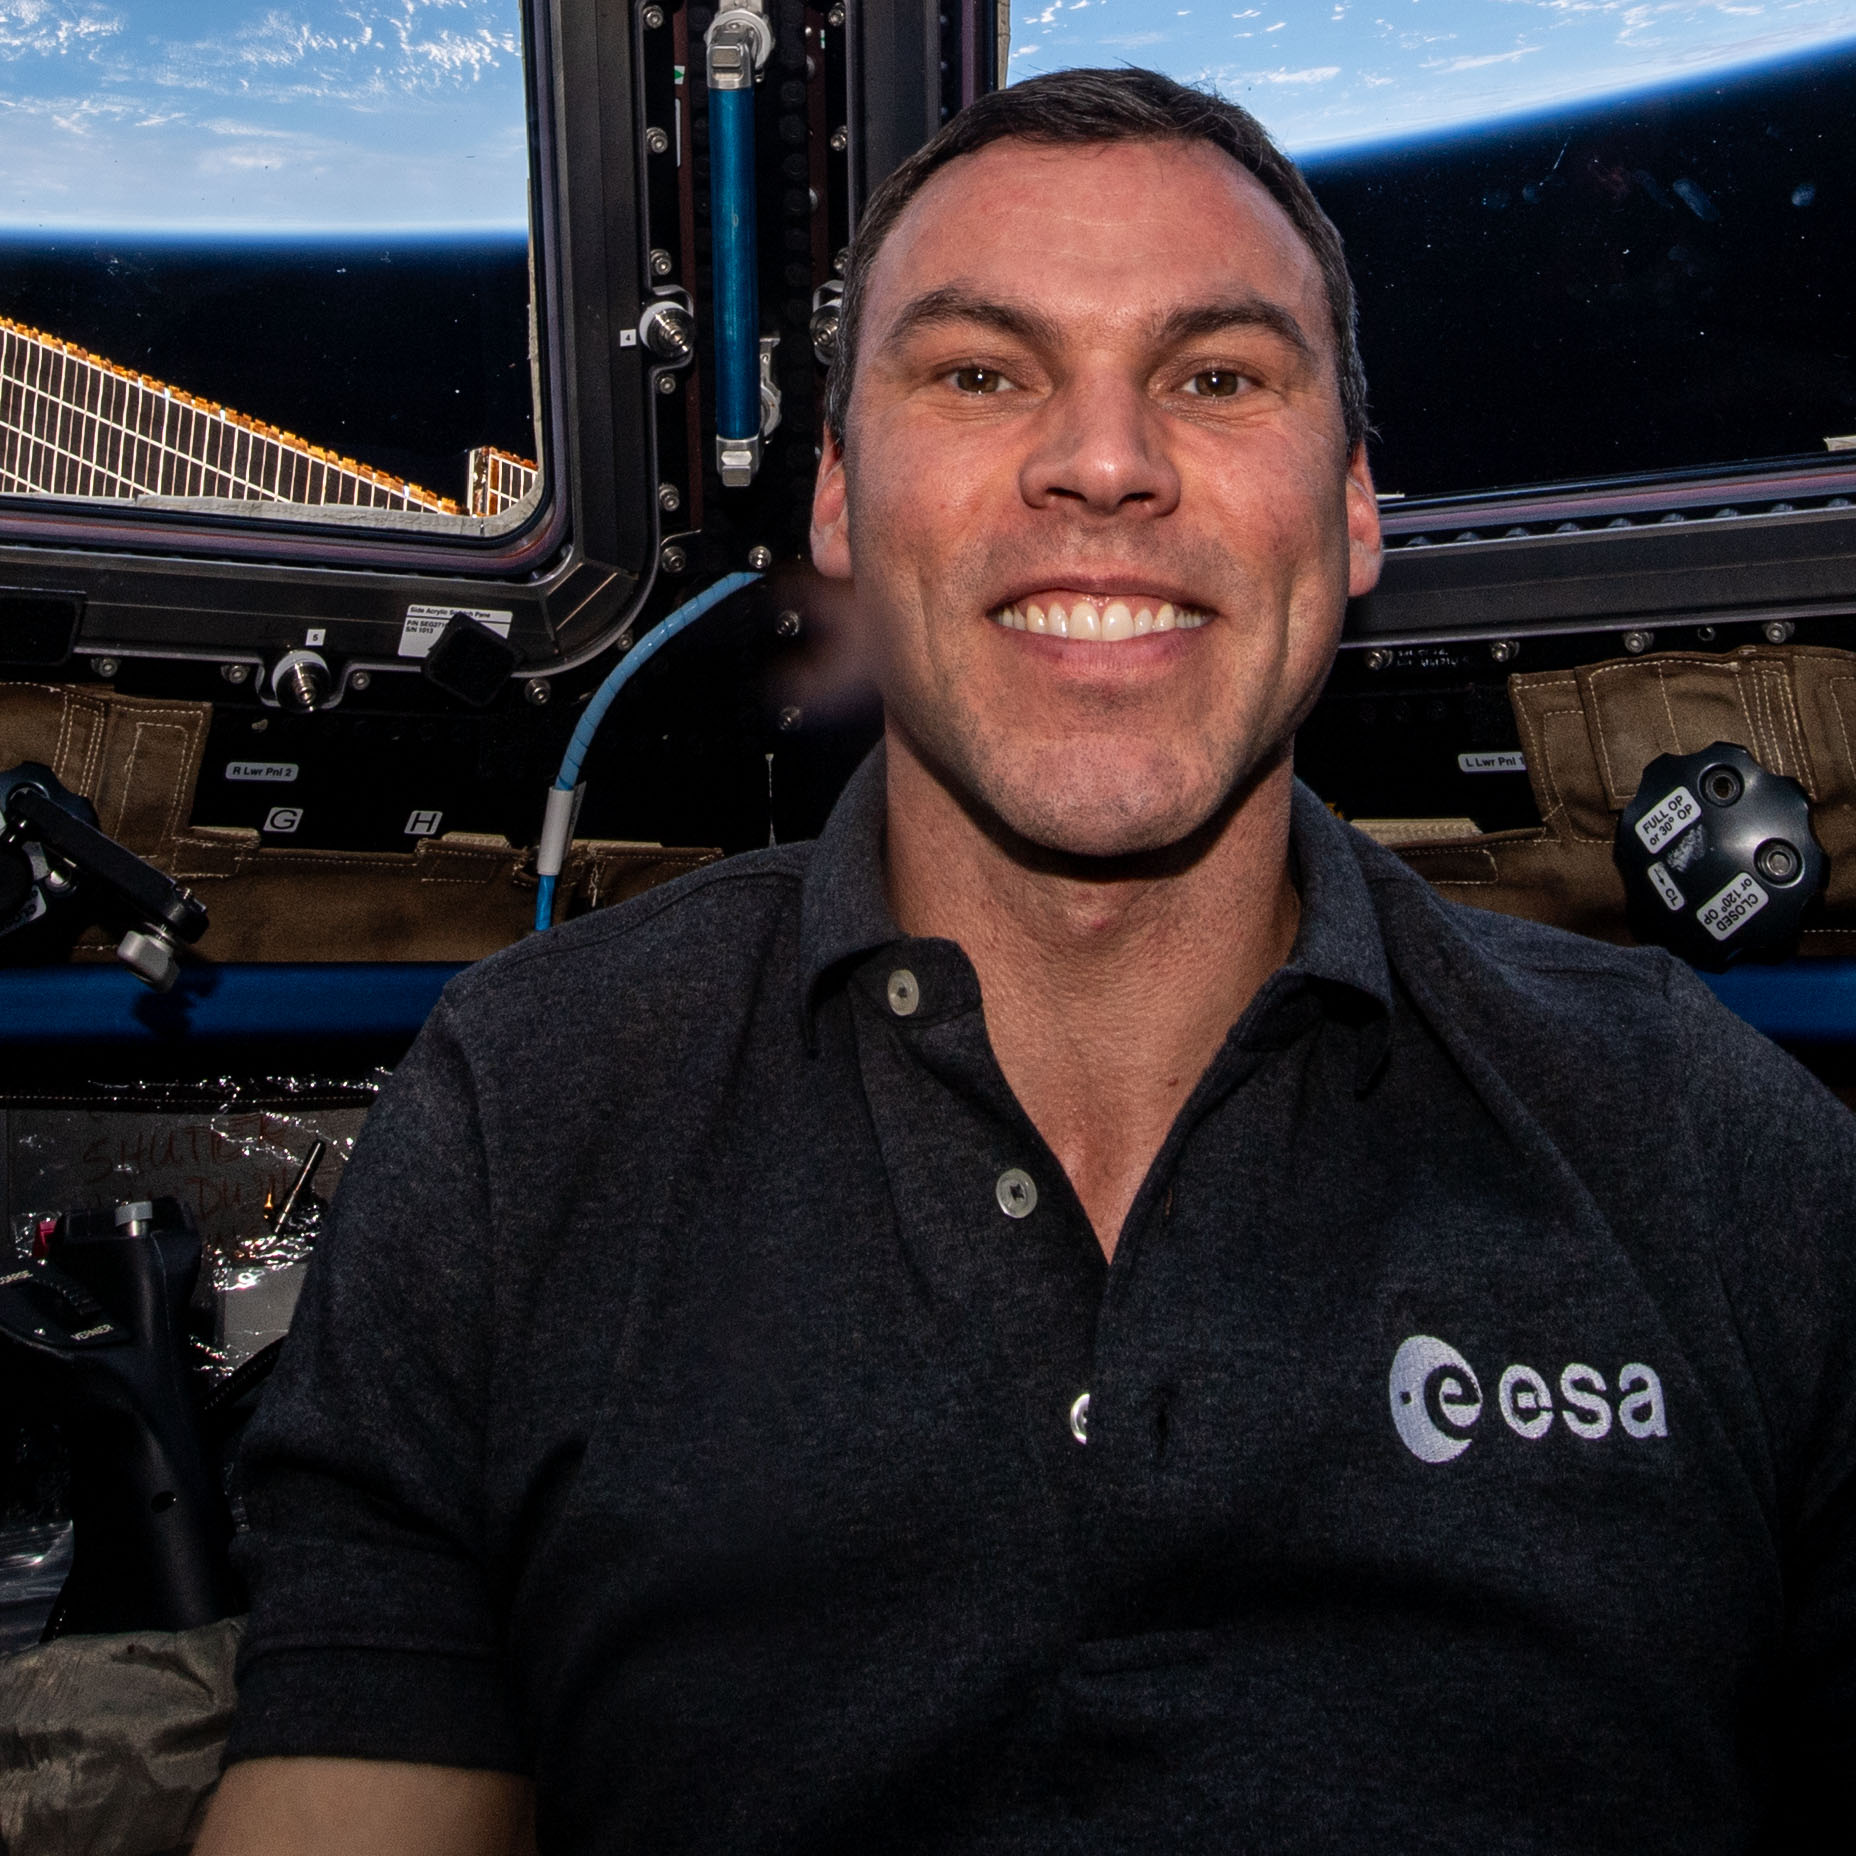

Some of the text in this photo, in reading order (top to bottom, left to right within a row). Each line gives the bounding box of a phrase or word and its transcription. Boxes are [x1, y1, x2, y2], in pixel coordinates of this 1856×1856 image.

[410, 606, 492, 620] Side Acrylic Pane
[1465, 756, 1516, 768] L Lwr Pnl
[233, 767, 284, 776] R Lwr Pnl
[271, 809, 298, 830] G
[410, 813, 438, 832] H
[1642, 795, 1684, 834] FULL OP
[1649, 804, 1694, 846] or OP
[1741, 878, 1752, 890] or
[1664, 888, 1678, 906] CL
[1703, 908, 1720, 926] OP
[1716, 893, 1760, 932] CLOSED
[1497, 1362, 1668, 1440] esa
